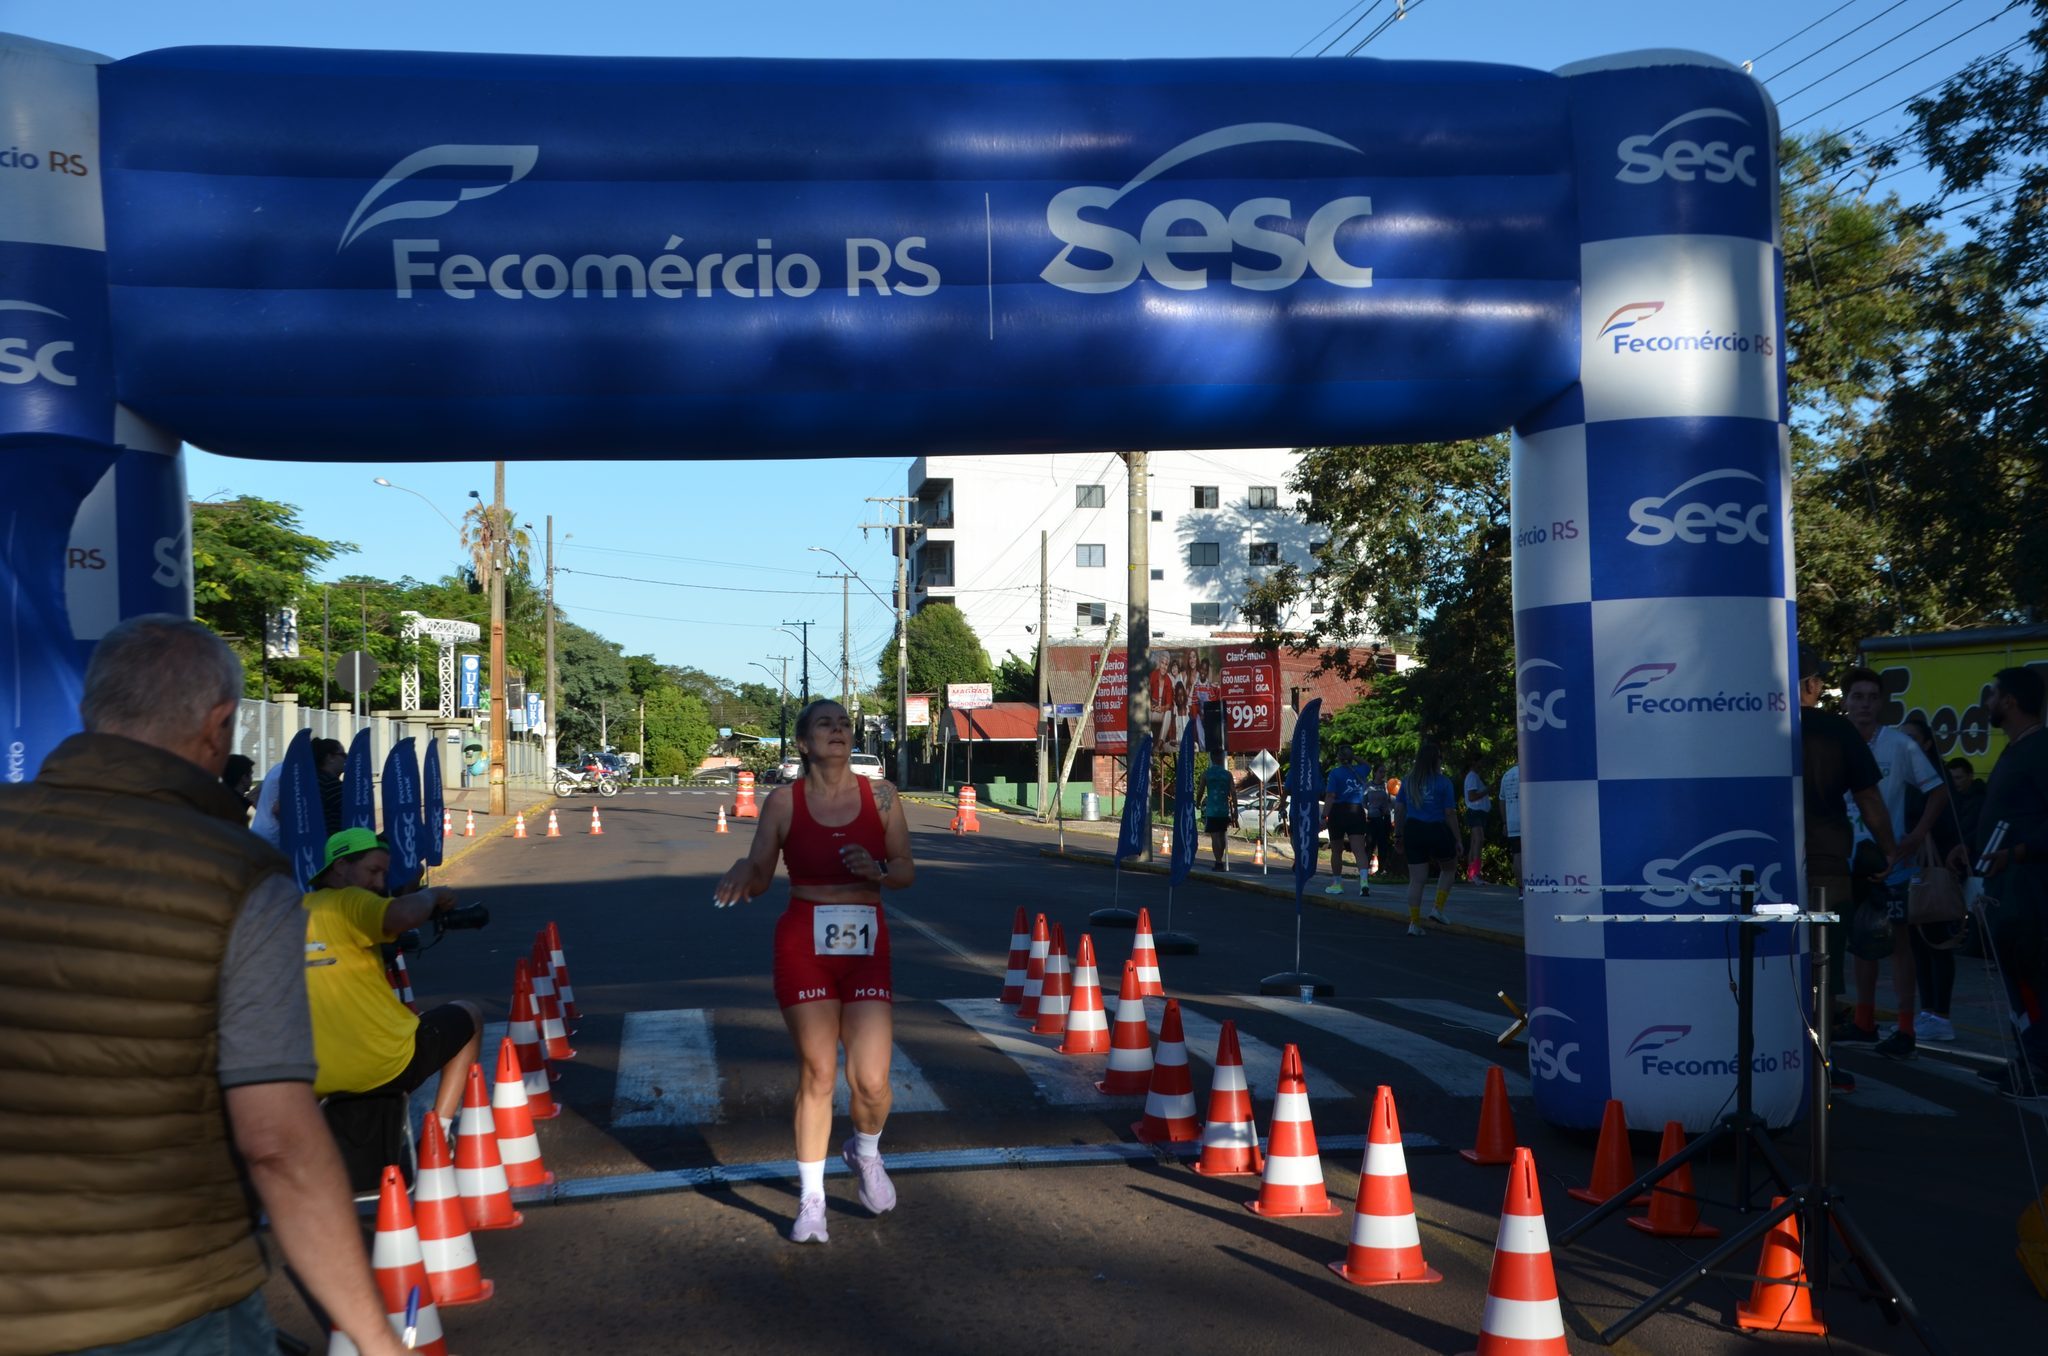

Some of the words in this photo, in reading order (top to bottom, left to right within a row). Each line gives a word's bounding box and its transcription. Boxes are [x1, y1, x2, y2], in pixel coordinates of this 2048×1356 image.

[48, 150, 89, 177] RS
[1615, 134, 1757, 188] Sesc
[1040, 185, 1373, 294] Sesc
[391, 233, 821, 300] Fecomércio
[845, 236, 942, 297] RS
[1613, 330, 1750, 355] Fecomércio
[1754, 335, 1774, 356] RS
[1551, 519, 1579, 542] RS
[1625, 496, 1769, 546] Sesc
[67, 547, 107, 570] RS
[465, 672, 477, 706] URI
[1222, 676, 1234, 684] 600
[1234, 675, 1251, 684] MEGA
[1255, 674, 1264, 682] 60
[1255, 684, 1270, 692] GIGA
[1627, 692, 1763, 714] Fecomércio
[1767, 692, 1786, 712] RS
[825, 923, 869, 950] 851
[799, 987, 827, 1000] RUN
[1642, 1052, 1778, 1076] Fecomécio
[1782, 1049, 1801, 1070] RS
